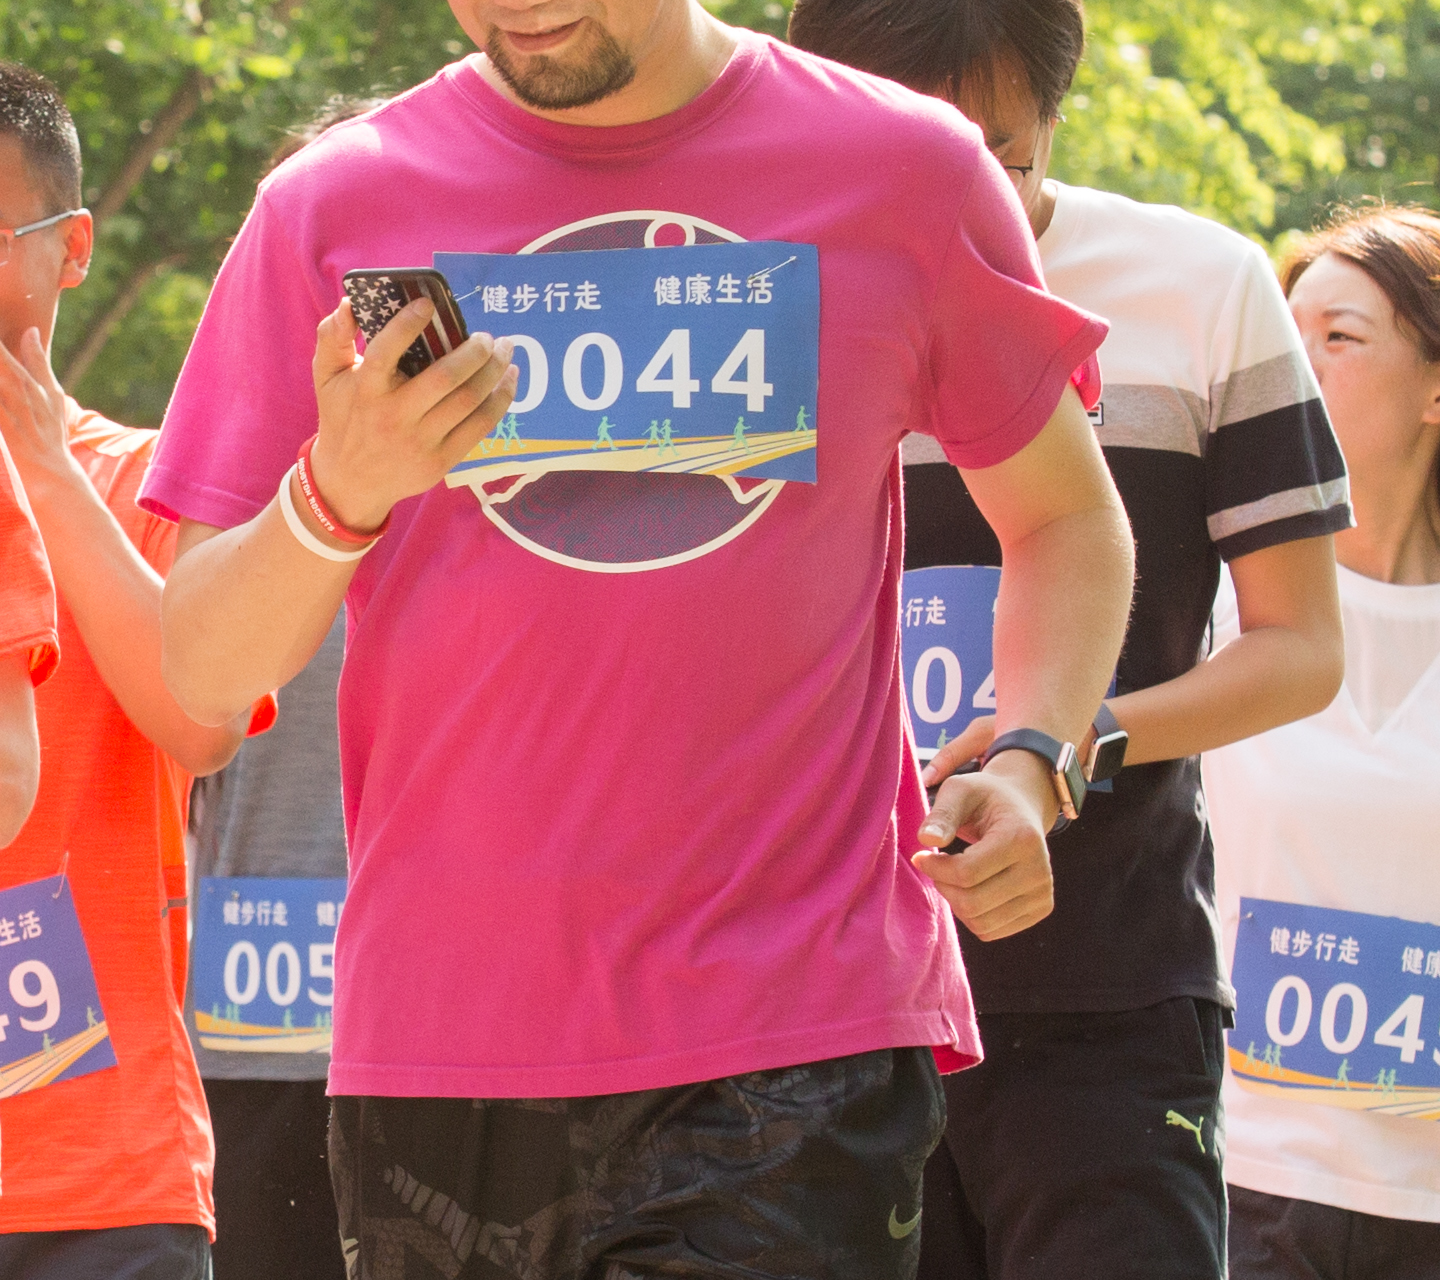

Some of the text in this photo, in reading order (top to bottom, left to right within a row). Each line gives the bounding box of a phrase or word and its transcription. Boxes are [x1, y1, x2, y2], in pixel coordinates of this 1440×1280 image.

[481, 273, 775, 313] 健步行走 健康生活
[506, 328, 774, 413] 0044
[298, 457, 335, 532] HOUSTON ROCKETS
[900, 595, 947, 628] 行走
[1270, 927, 1360, 965] 健步行走
[223, 940, 334, 1007] 005
